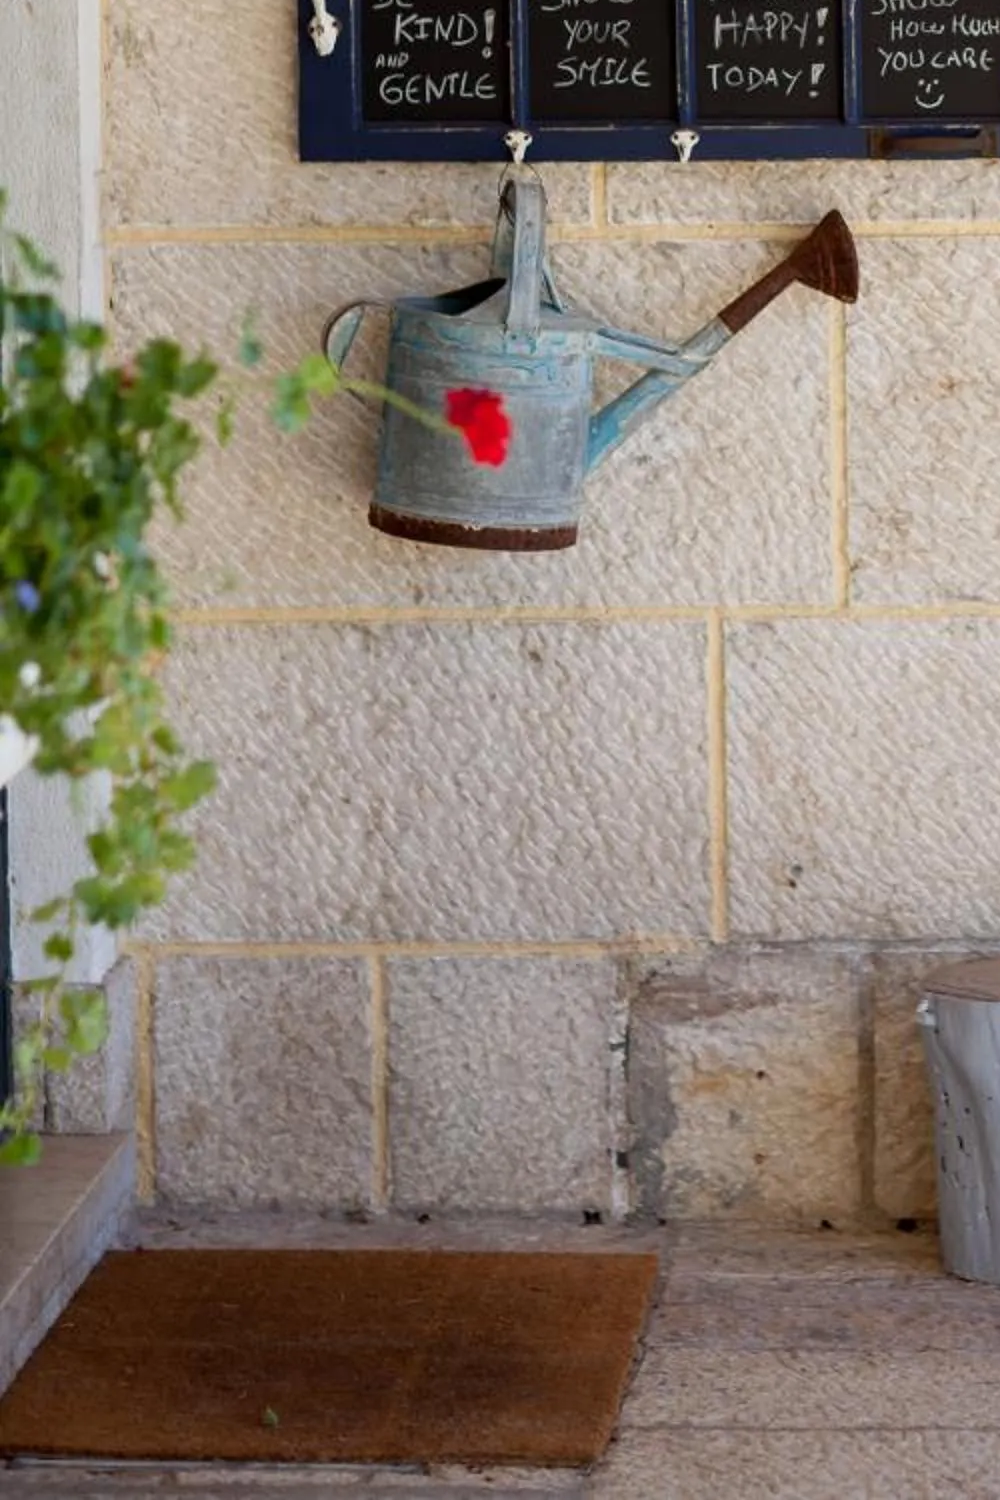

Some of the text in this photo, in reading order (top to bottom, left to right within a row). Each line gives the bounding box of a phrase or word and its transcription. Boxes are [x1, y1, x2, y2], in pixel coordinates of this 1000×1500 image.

[394, 8, 496, 59] KIND!
[564, 20, 630, 50] YOUR
[714, 7, 829, 49] HAPPY!
[891, 19, 945, 41] HOW
[375, 53, 409, 68] AND
[553, 57, 651, 87] SMILE
[878, 46, 993, 77] YOU CARE
[380, 71, 496, 104] GENTLE
[706, 64, 825, 97] TODAY!
